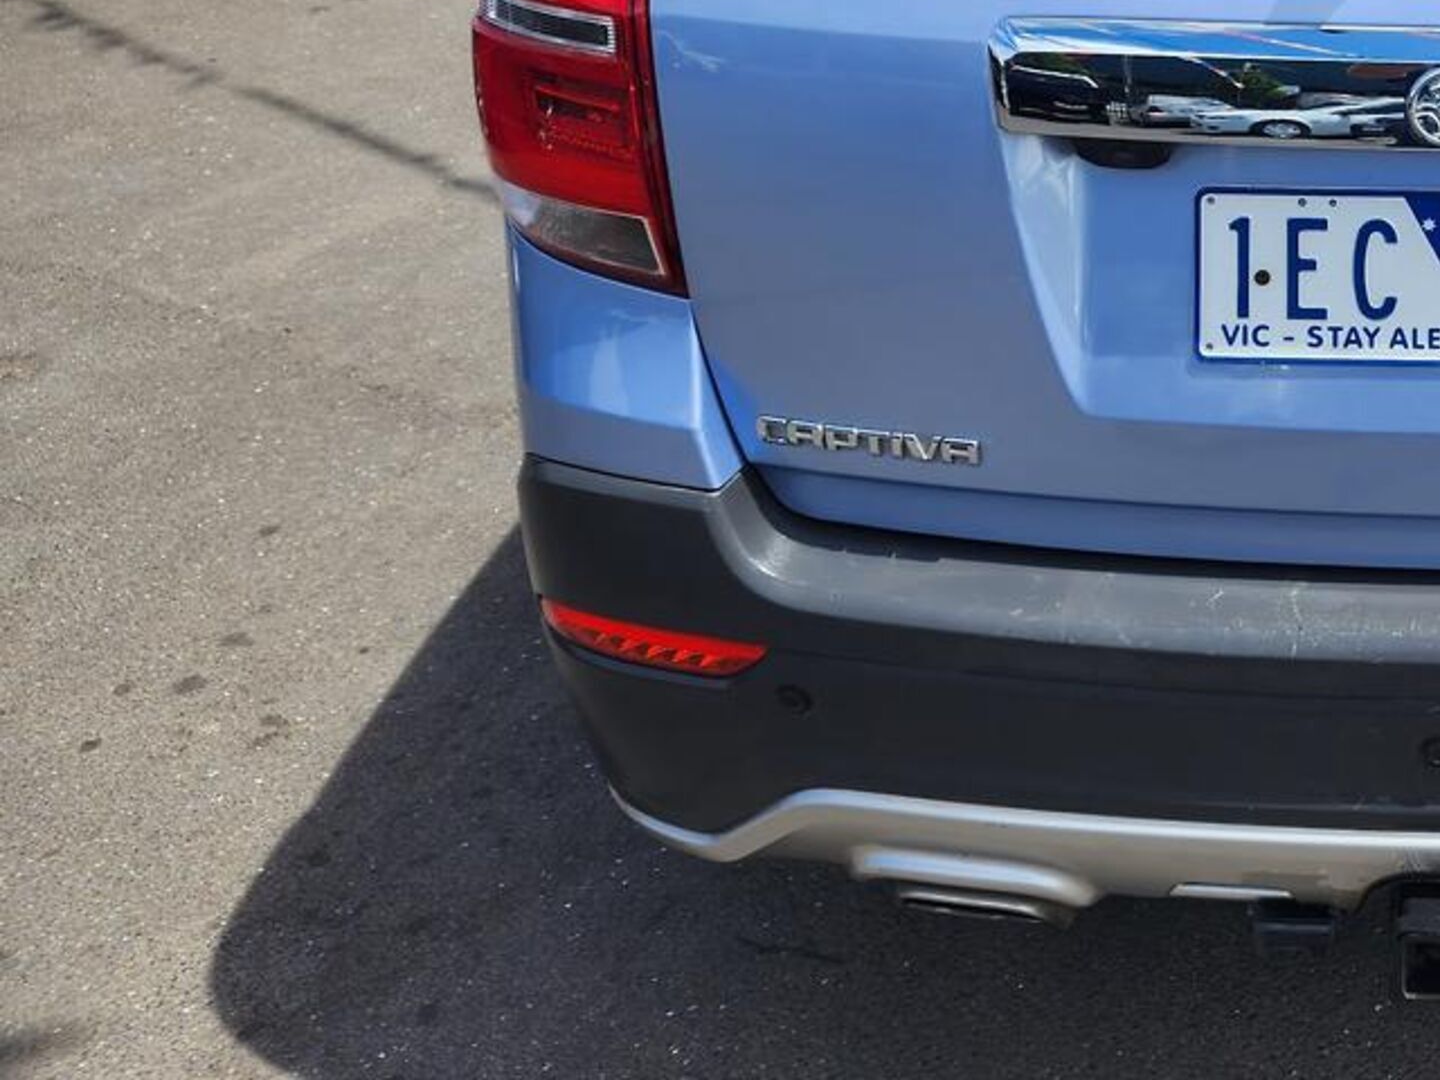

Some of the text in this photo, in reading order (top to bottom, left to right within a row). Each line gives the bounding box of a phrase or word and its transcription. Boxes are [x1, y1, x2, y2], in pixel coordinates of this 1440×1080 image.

[1228, 217, 1398, 321] 1EC
[1221, 324, 1270, 348] VIC
[1307, 325, 1381, 350] STAY
[756, 414, 982, 466] CAPTIVA
